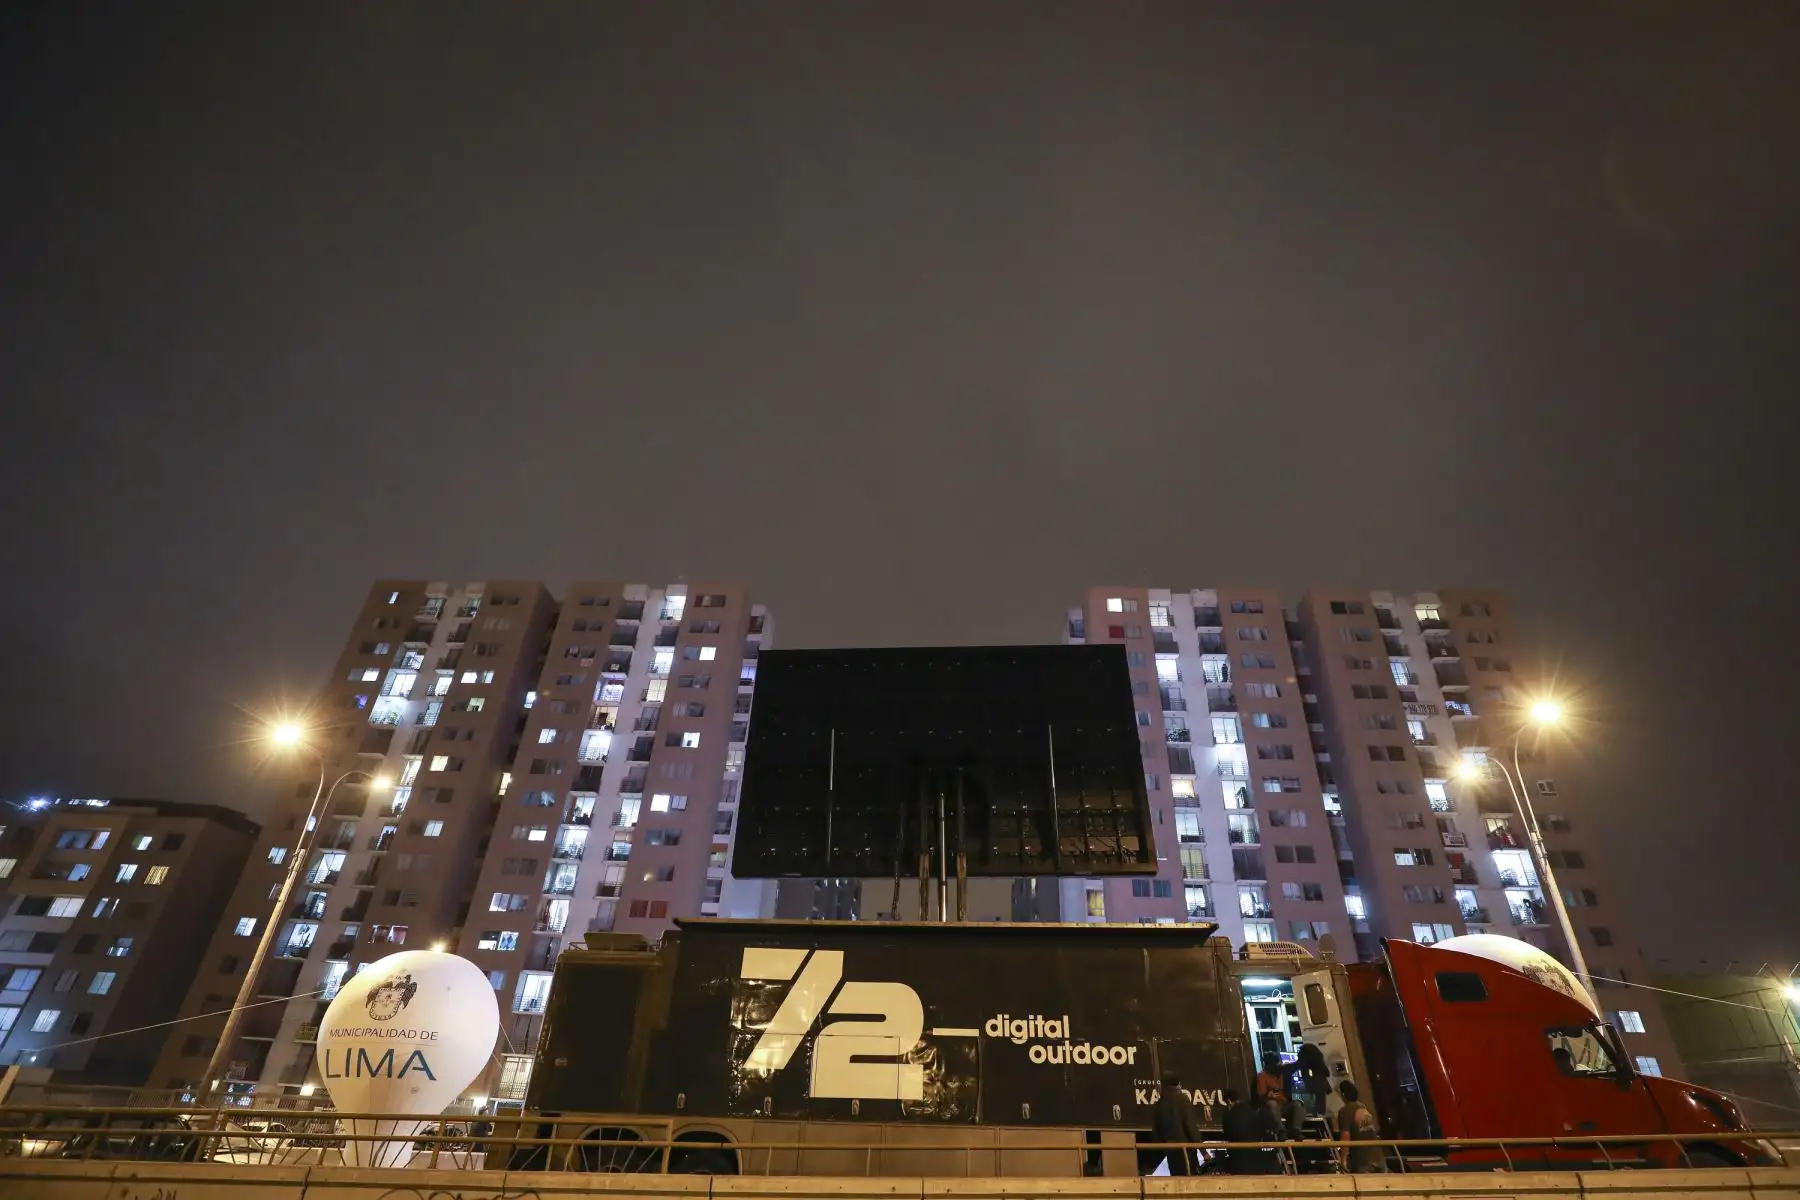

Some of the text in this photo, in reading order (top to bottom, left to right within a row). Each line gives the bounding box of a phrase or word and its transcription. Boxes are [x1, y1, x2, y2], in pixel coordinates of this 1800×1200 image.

[329, 1027, 439, 1041] MUNICIPALIDAD DE
[985, 1014, 1070, 1045] digital
[326, 1047, 437, 1081] LIMA
[1028, 1040, 1137, 1065] outdoor
